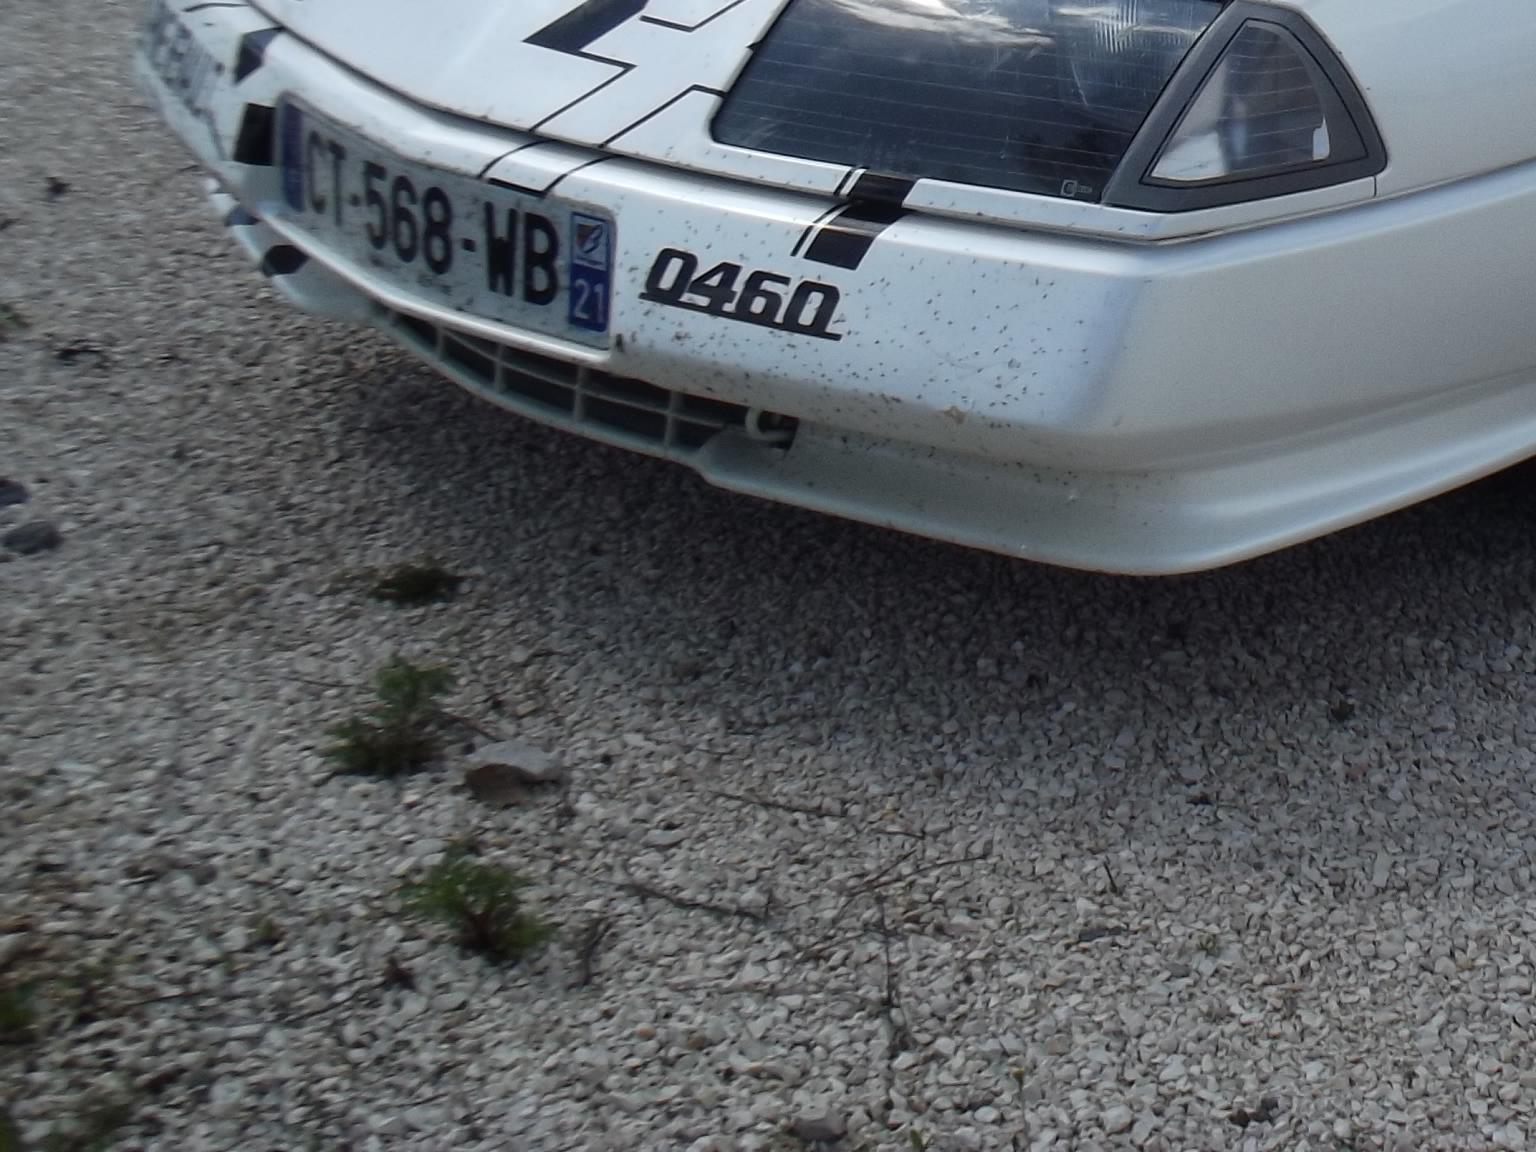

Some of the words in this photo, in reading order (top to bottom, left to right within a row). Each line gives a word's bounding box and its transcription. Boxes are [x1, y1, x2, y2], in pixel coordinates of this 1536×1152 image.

[306, 129, 560, 306] CT-568-WB
[571, 276, 606, 320] 21
[638, 248, 843, 341] 0460
